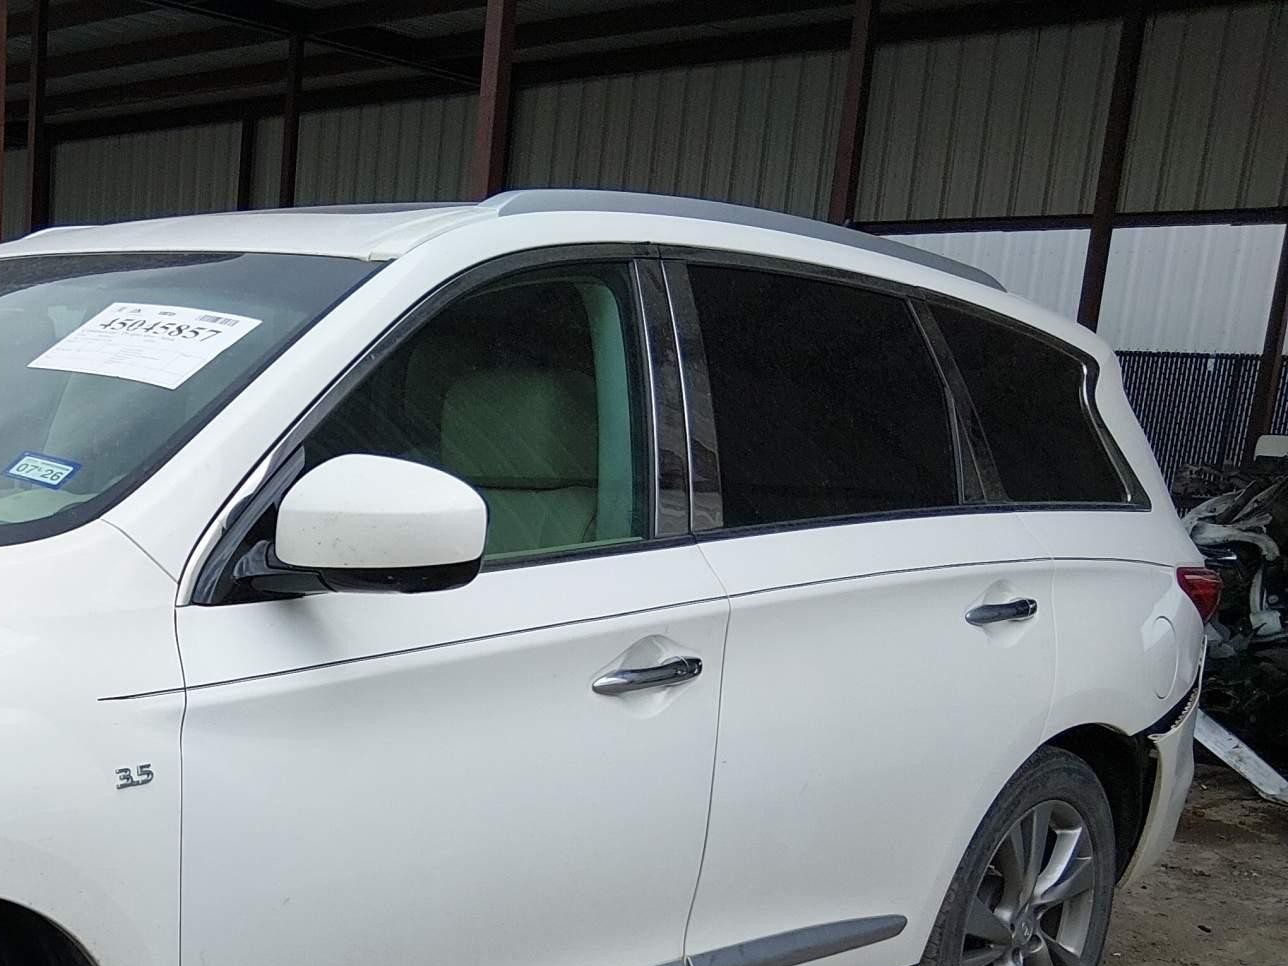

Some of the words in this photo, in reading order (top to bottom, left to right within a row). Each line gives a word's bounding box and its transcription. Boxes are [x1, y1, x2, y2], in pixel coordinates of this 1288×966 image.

[99, 317, 223, 342] 45045857
[15, 463, 39, 474] 07
[40, 469, 64, 481] 26
